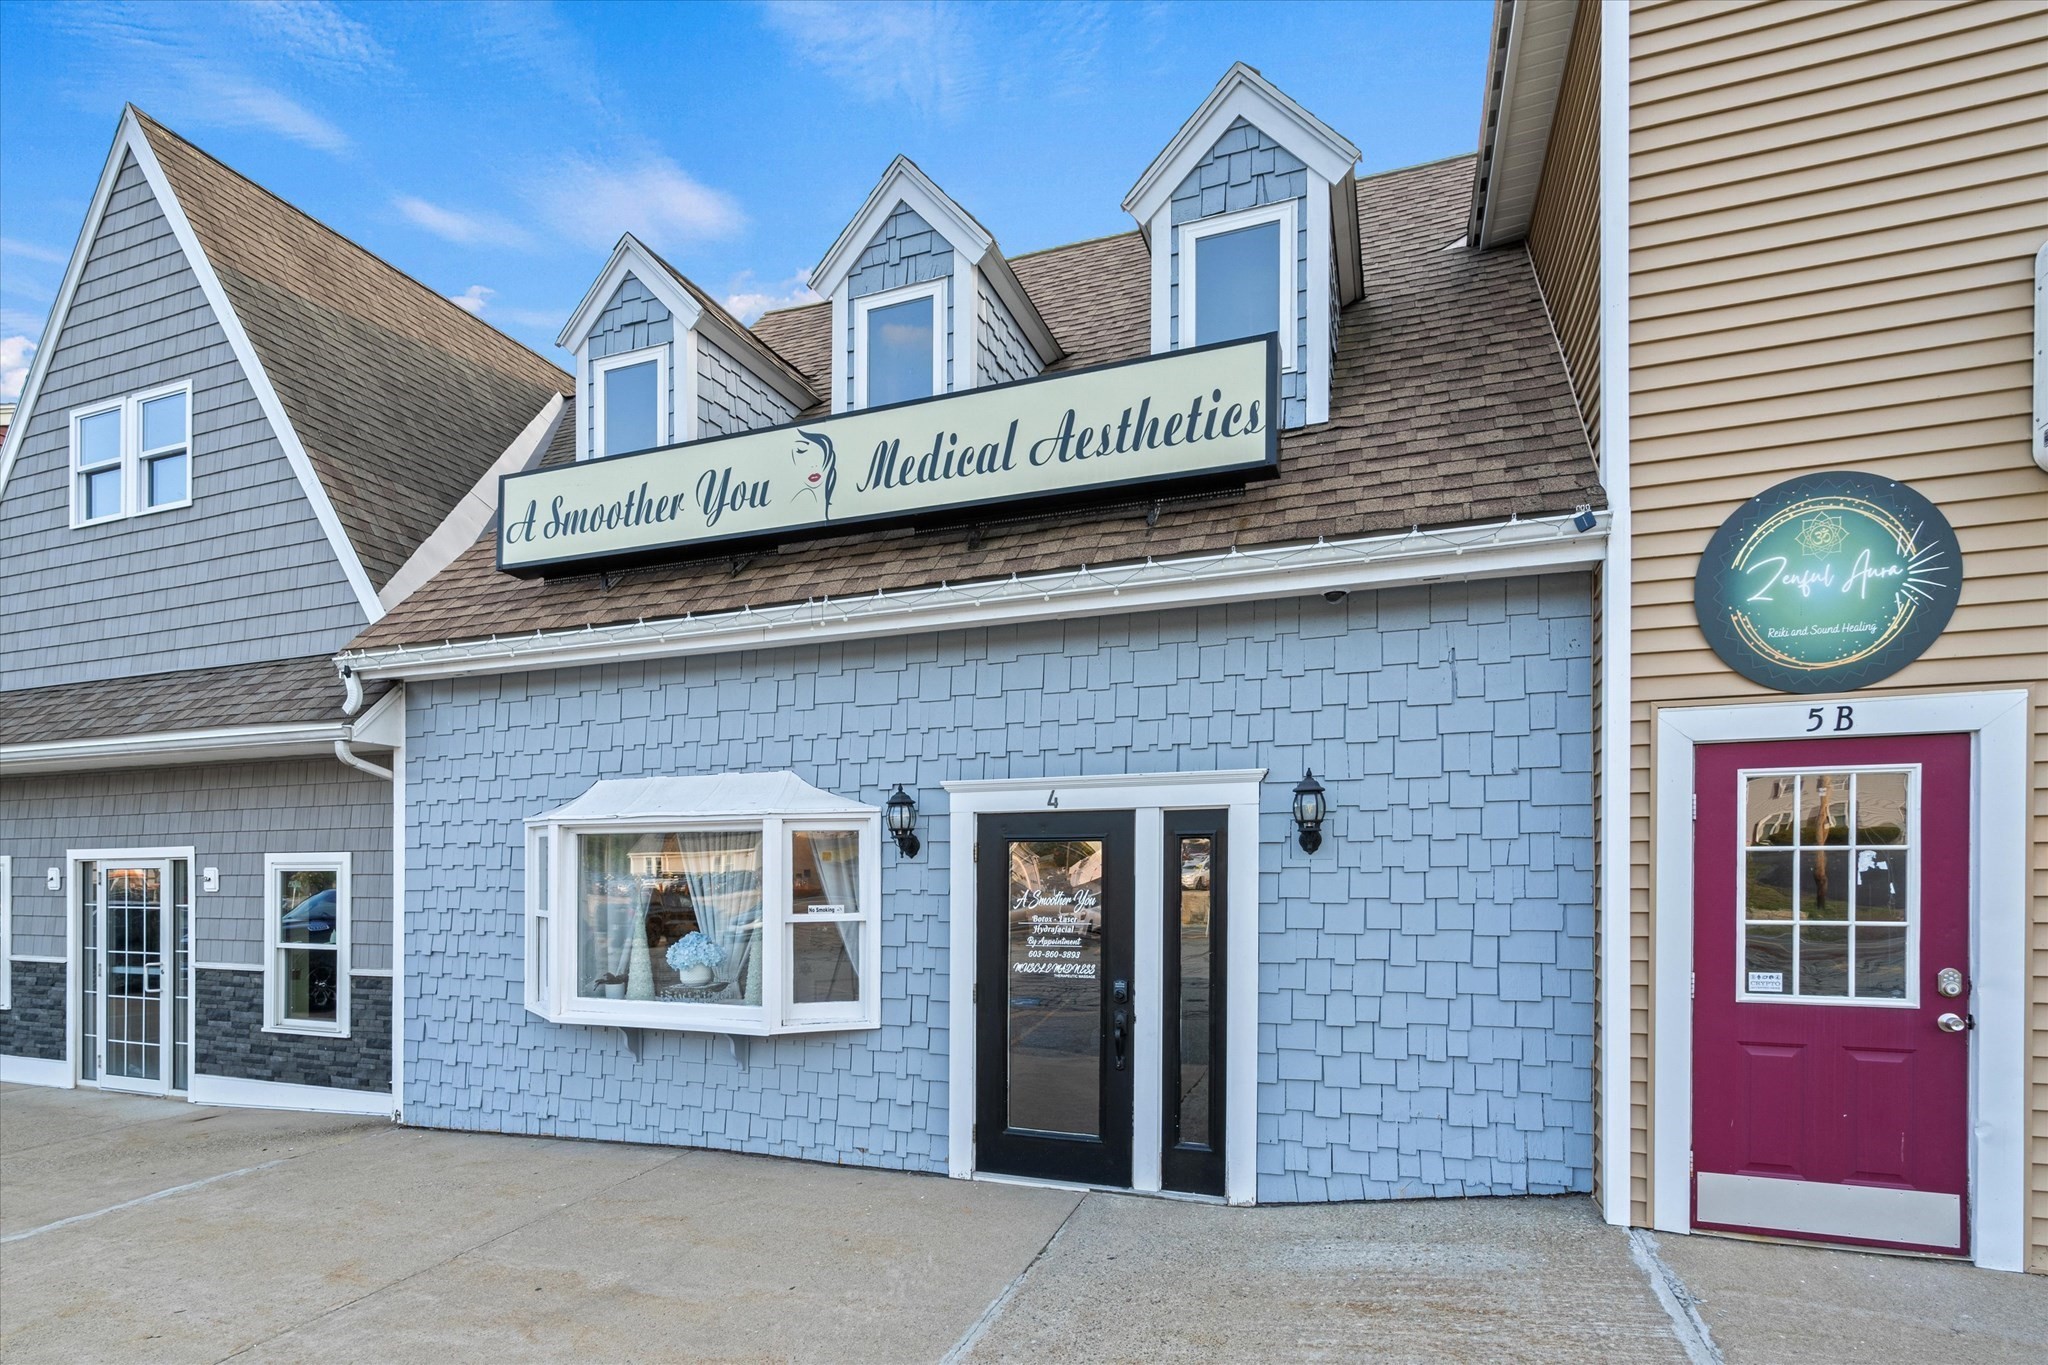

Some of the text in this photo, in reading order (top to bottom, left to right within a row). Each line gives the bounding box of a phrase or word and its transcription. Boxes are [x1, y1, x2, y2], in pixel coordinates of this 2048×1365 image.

[506, 388, 1266, 544] A Smoother You Medical Aesthetics
[1746, 549, 1903, 601] Zenful Aura
[1768, 622, 1878, 638] Reiki and Sound Healing
[1806, 706, 1853, 732] 5 B
[1047, 789, 1058, 808] 4
[1013, 889, 1096, 913] A Smoother You
[1032, 915, 1052, 923] Botox
[1059, 915, 1077, 923] Laser
[1032, 924, 1075, 934] Hydrafacial
[1027, 936, 1082, 948] By Appointment
[1028, 950, 1080, 958] 603-860-3893
